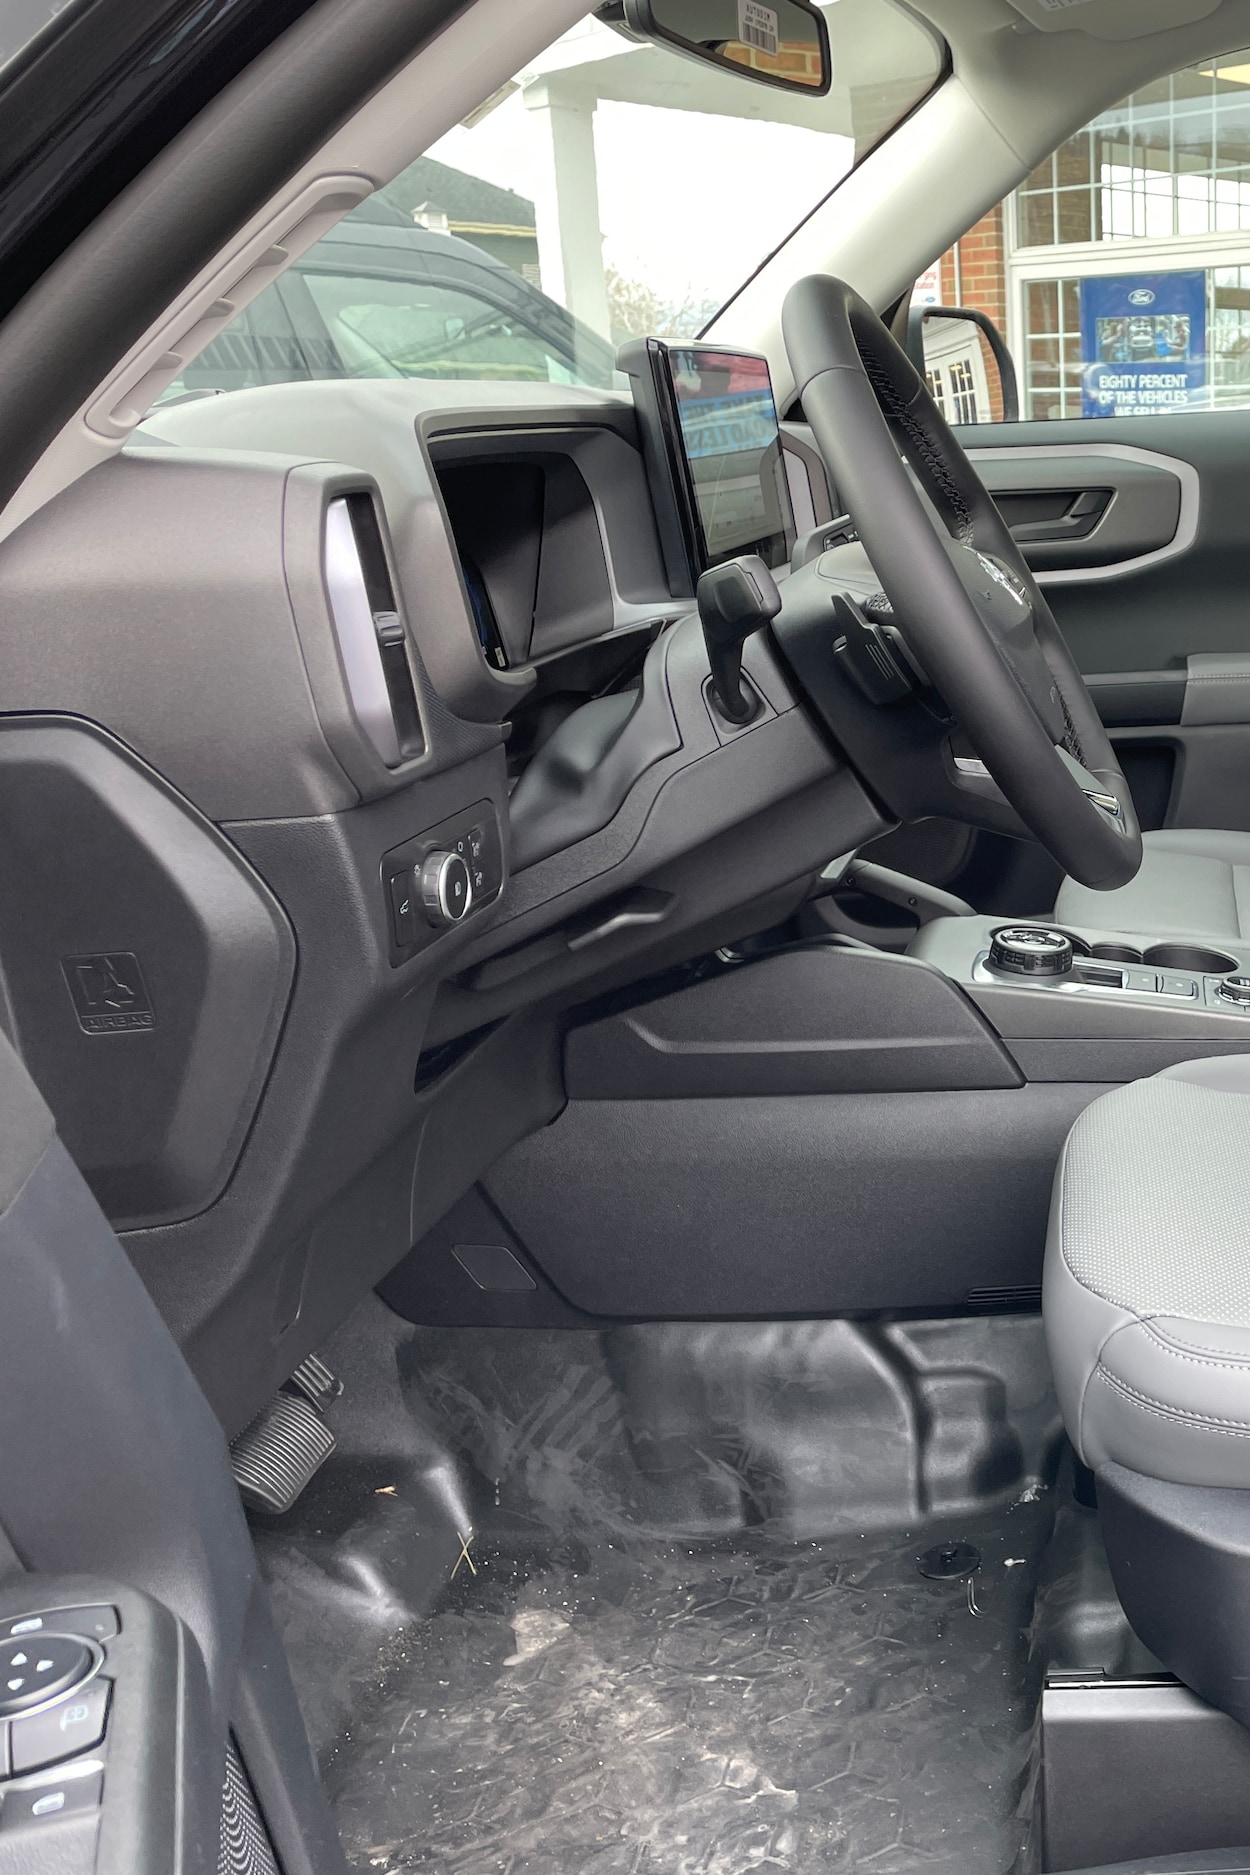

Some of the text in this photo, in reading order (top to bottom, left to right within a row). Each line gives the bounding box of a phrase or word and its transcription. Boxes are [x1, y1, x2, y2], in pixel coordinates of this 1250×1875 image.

[1099, 373, 1188, 389] EIGHTY PERCENT
[1098, 389, 1188, 404] OF THE VEHICLES
[86, 1013, 153, 1029] AIRBAG
